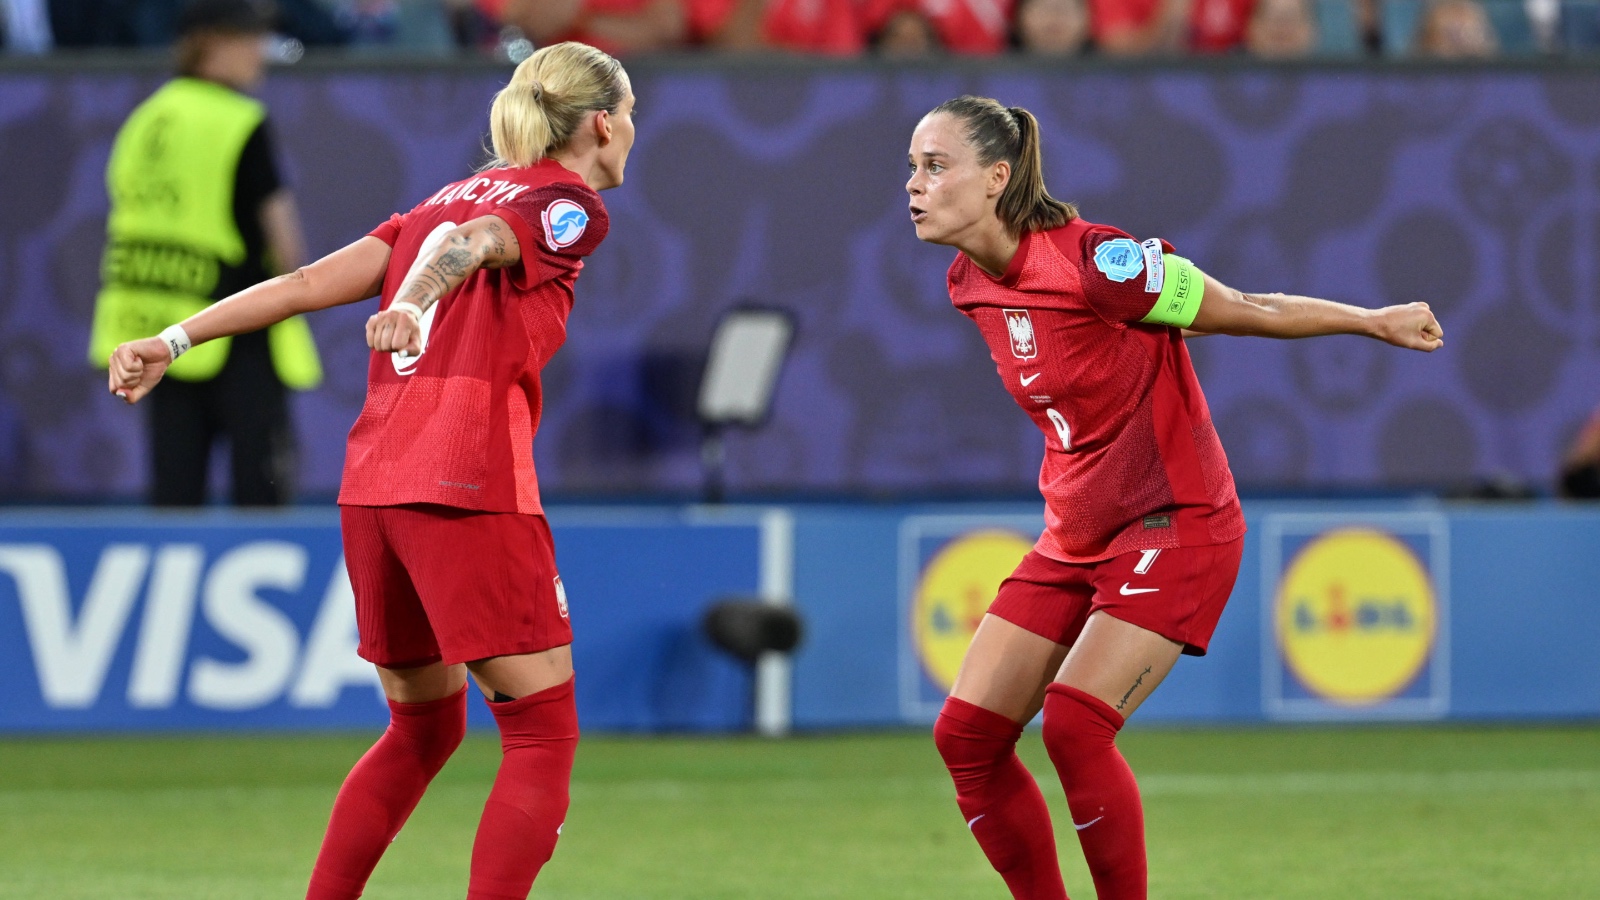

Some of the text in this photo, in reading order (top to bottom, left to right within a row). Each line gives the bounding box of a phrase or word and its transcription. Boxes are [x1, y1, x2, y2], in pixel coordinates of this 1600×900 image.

[1176, 262, 1189, 299] RESPE
[1046, 408, 1073, 450] 9
[0, 540, 392, 710] VISA
